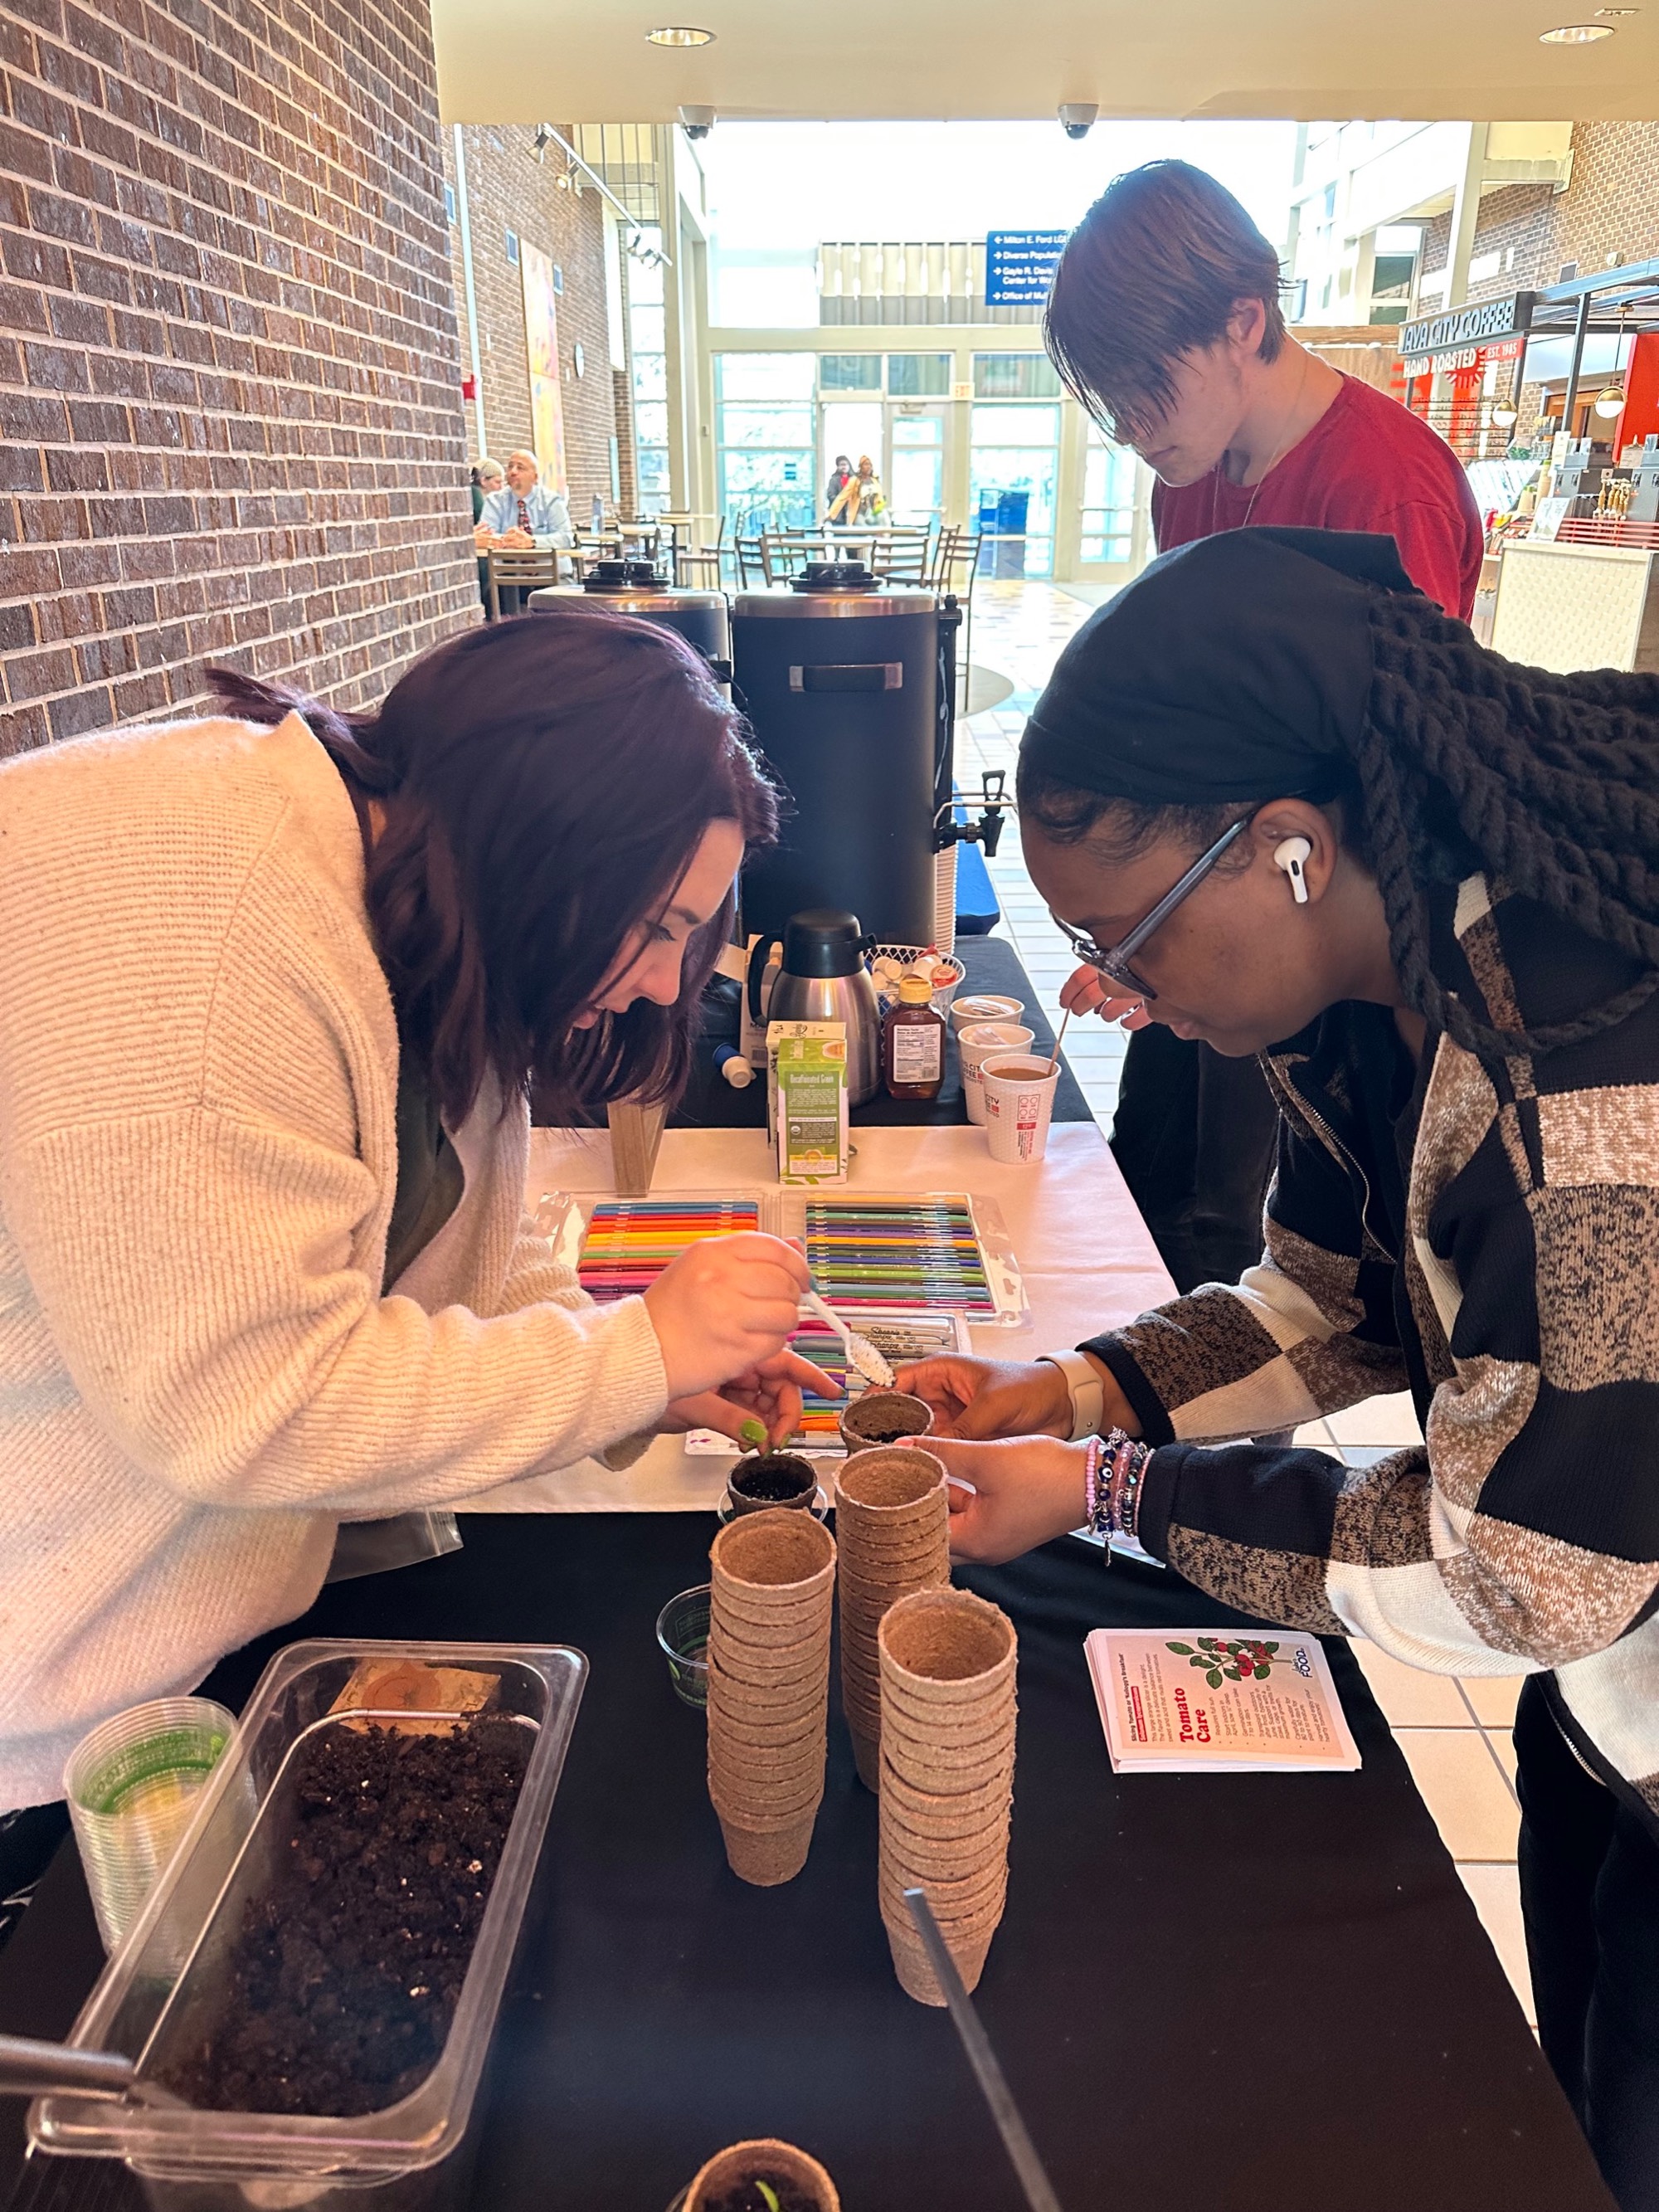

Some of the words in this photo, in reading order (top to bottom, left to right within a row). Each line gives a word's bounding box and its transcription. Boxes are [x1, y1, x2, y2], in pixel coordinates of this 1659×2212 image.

[1035, 235, 1053, 244] Ford
[1029, 251, 1061, 260] Populatio
[1430, 314, 1462, 345] CITY
[1461, 300, 1515, 339] COFFEE
[1403, 357, 1430, 378] HAND
[1430, 348, 1477, 374] ROASTED
[1487, 347, 1501, 359] EST.
[1502, 342, 1518, 356] 1985
[1296, 1651, 1313, 1678] FOOD
[1175, 1688, 1193, 1742] Tomato
[1196, 1710, 1210, 1742] Care
